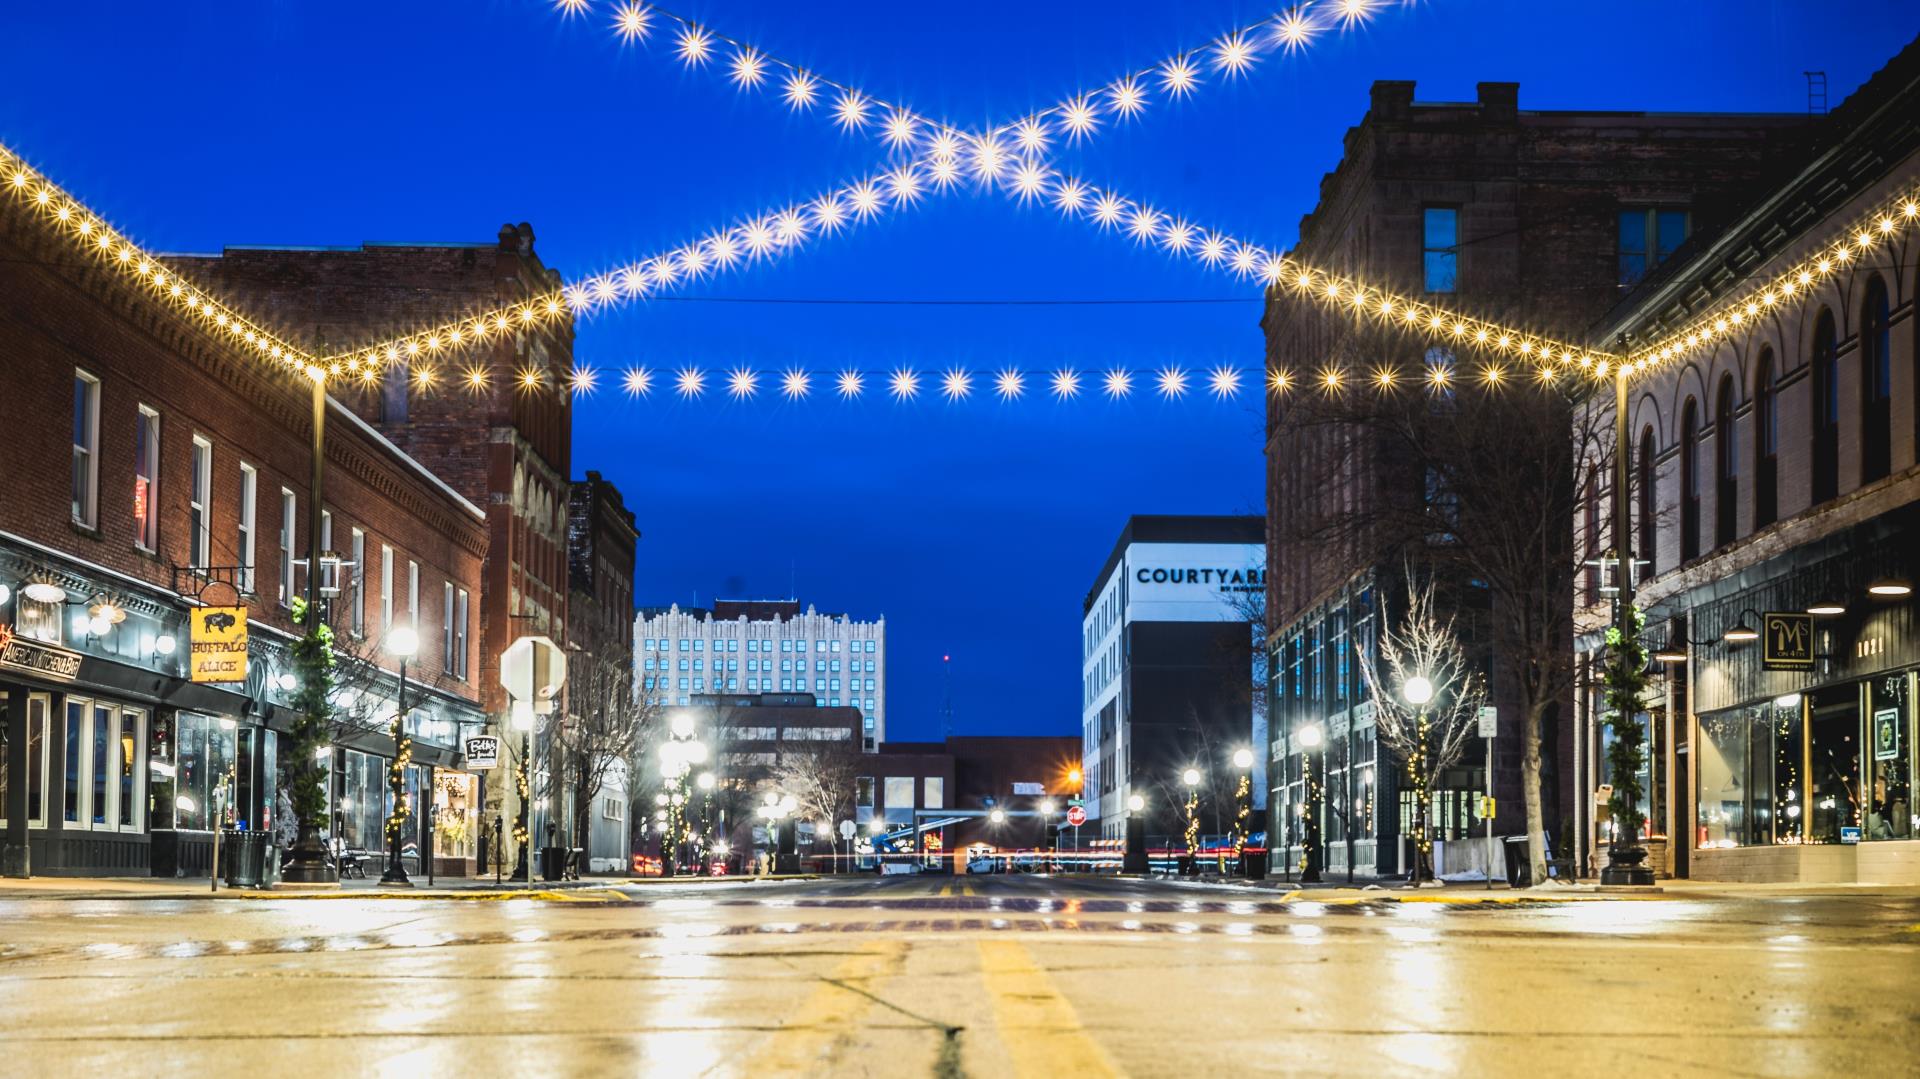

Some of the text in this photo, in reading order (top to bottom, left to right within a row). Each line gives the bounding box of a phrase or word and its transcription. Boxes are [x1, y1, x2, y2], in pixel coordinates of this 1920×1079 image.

[191, 642, 247, 654] BUFFALO
[1858, 636, 1883, 658] 1021
[198, 661, 238, 673] ALICE
